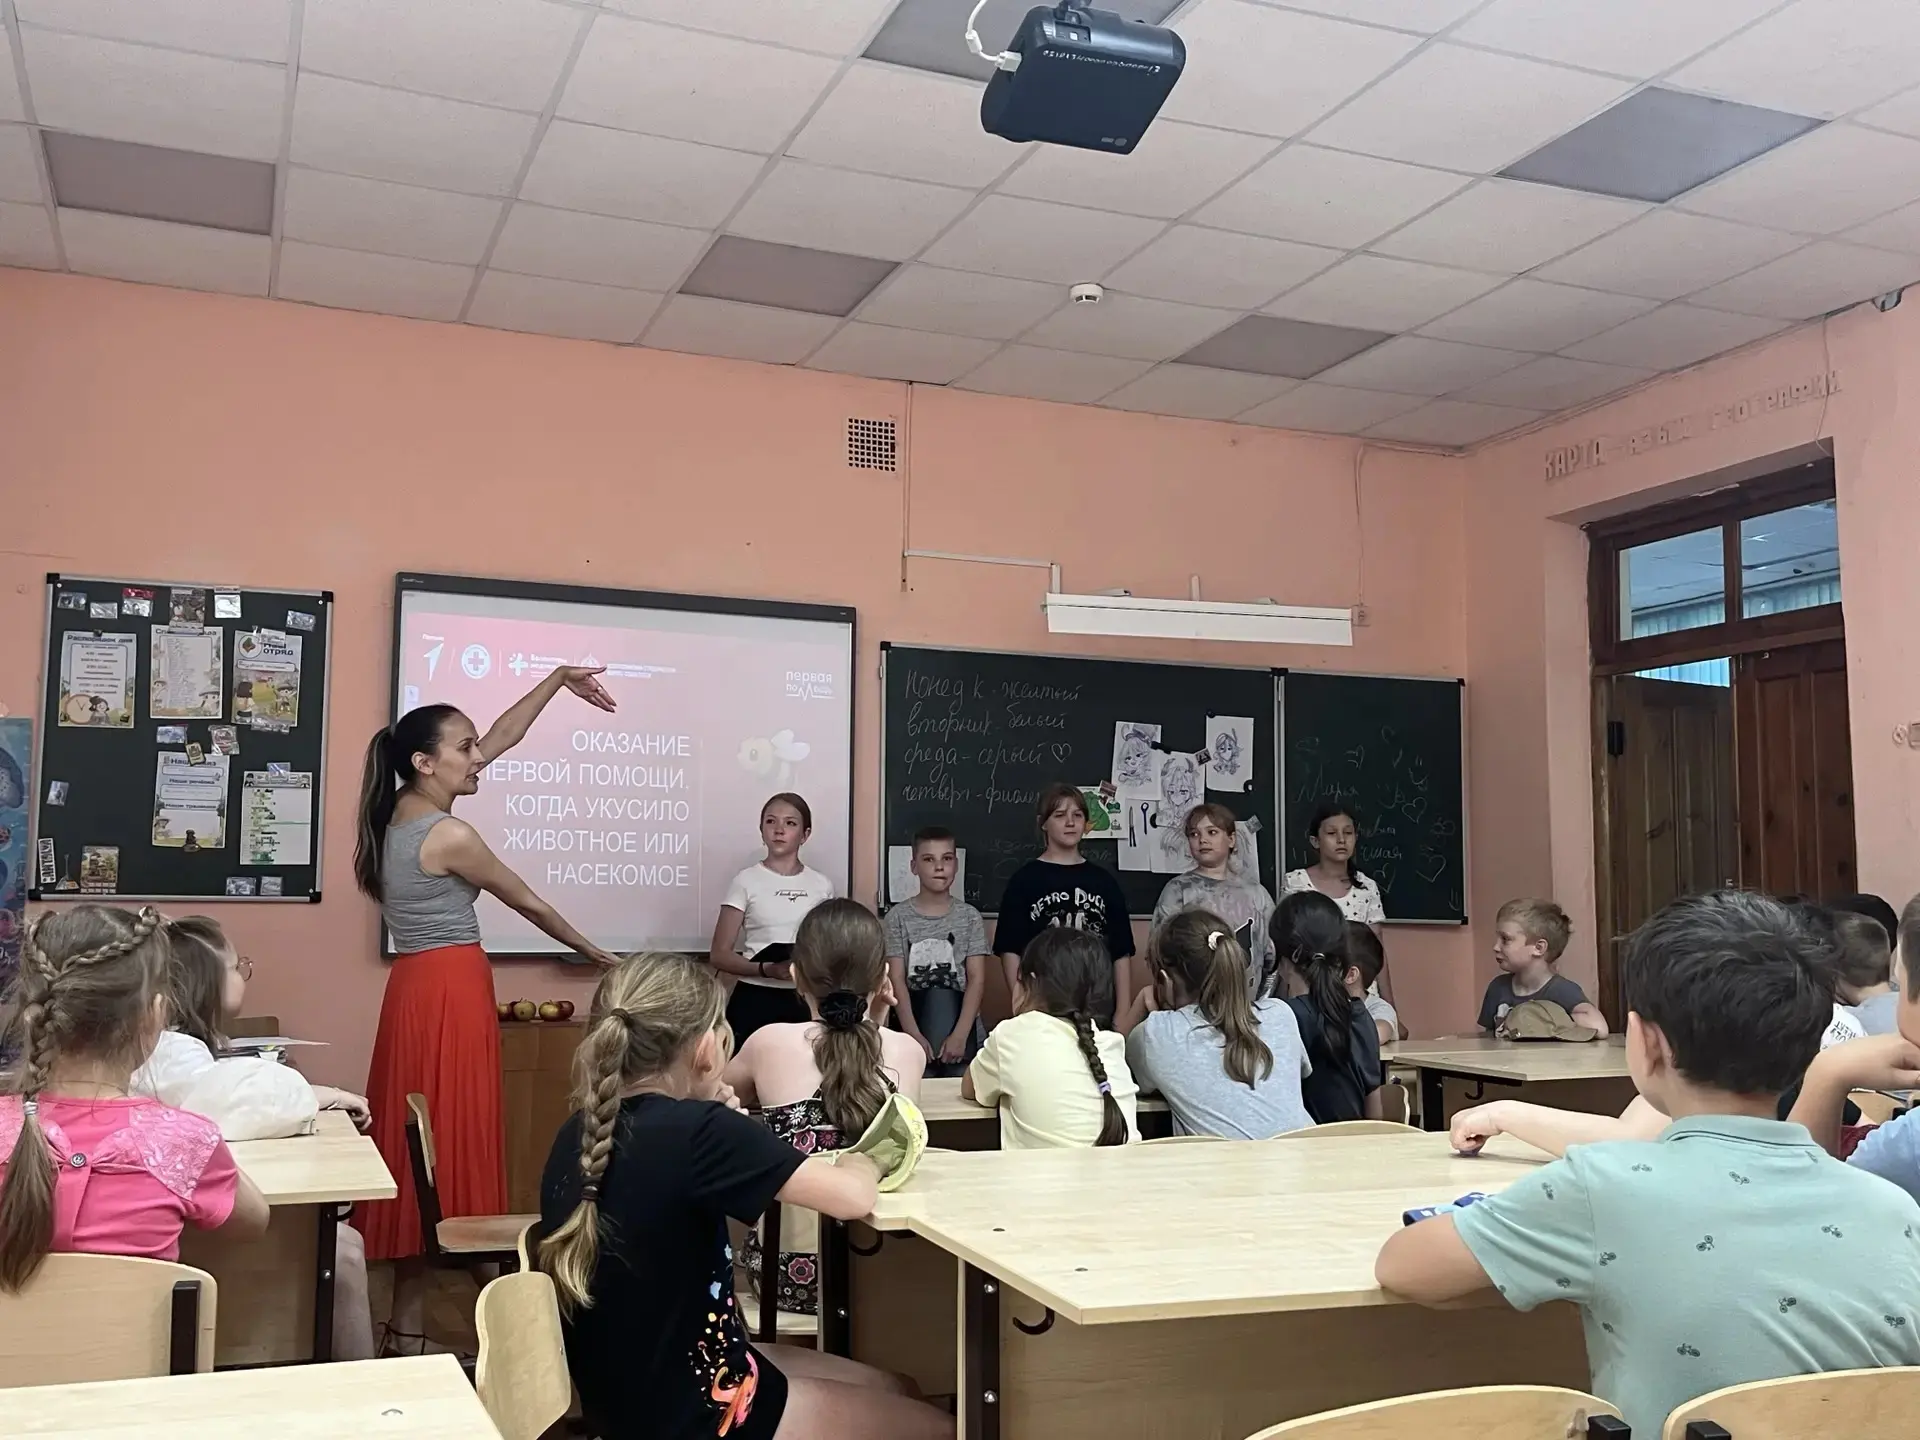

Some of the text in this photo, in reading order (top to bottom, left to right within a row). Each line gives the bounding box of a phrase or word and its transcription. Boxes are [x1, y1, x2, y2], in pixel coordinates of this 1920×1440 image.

[1544, 438, 1607, 482] КАРТА
[785, 670, 833, 686] первая
[571, 729, 692, 757] ОКАЗАНИЕ
[505, 793, 691, 822] КОГДА УКУСИЛО
[502, 827, 691, 855] ЖИВОТНОЕ ИЛИ
[546, 862, 691, 887] НАСЕКОМОЕ
